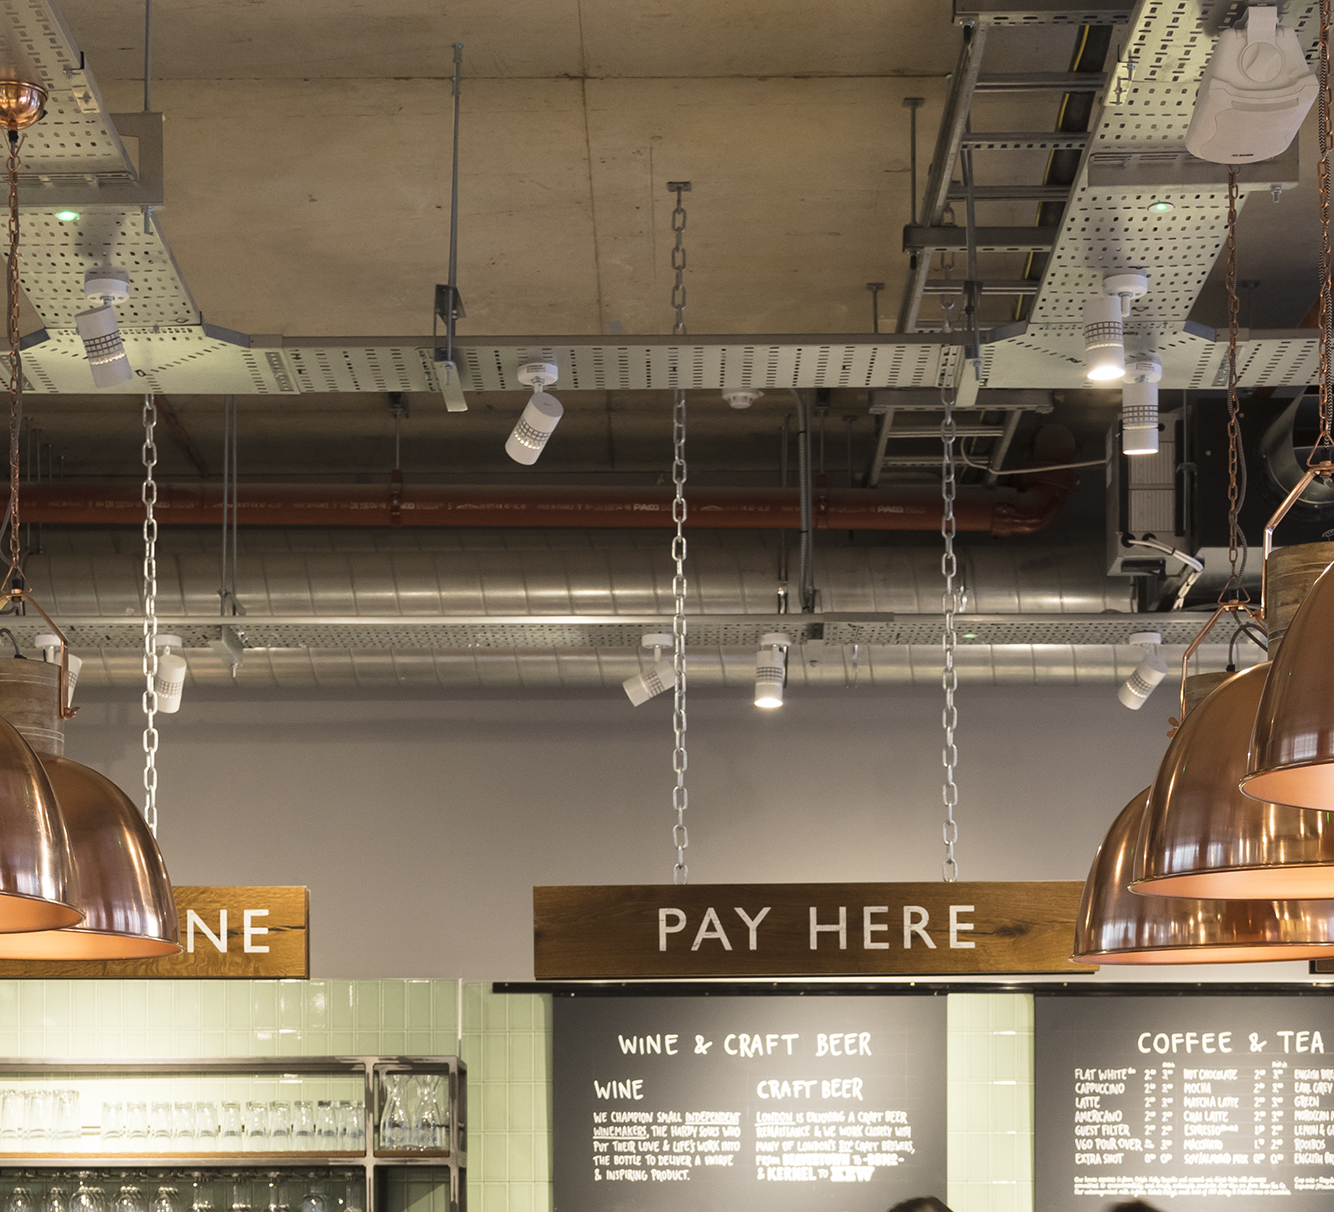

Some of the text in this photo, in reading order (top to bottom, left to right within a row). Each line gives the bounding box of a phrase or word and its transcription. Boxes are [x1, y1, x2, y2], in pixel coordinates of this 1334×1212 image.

[188, 908, 271, 953] NE
[658, 905, 976, 952] PAY HERE
[618, 1031, 872, 1058] WINE & CRAFT BEER
[1137, 1030, 1325, 1055] COFFEE & TEA
[1074, 1068, 1097, 1080] FLAT
[1098, 1068, 1127, 1080] WHITE
[1198, 1068, 1238, 1080] CHOCOLATE
[1294, 1068, 1319, 1080] ENGLISH
[593, 1079, 644, 1100] WINE
[756, 1077, 864, 1101] CRAFT BEER
[1074, 1082, 1126, 1094] CAPPUCCINO
[1183, 1082, 1212, 1094] MOCHA
[1294, 1082, 1333, 1095] EARL GREY
[1075, 1096, 1100, 1109] LATTE
[1183, 1095, 1239, 1108] MATCHA LATTE
[1294, 1095, 1319, 1108] GREEN
[593, 1111, 741, 1124] WE CHAMPION SMALL INDEPENDENT
[755, 1110, 908, 1125] LONDON IS ENJOYING A CRAFT BEER
[1074, 1109, 1123, 1123] AMERICANO
[1183, 1110, 1229, 1123] CHAI LATTE
[1294, 1109, 1329, 1121] MOROCCAN
[593, 1125, 741, 1139] WINEMAKERS, THE HARDY SOULS WHO
[756, 1125, 911, 1138] RENAISSANCE & WE WORK CLOSELY WITH
[1074, 1124, 1131, 1136] GUEST FILTER
[1183, 1124, 1221, 1136] ESPRESSO
[1294, 1124, 1318, 1136] LEMON
[1319, 1124, 1325, 1136] &
[593, 1140, 741, 1153] PUT THEIR LOVE & LIFE'S WORK INTO
[756, 1140, 779, 1152] MANY
[782, 1140, 794, 1152] OF
[797, 1140, 836, 1152] LONDON'S
[855, 1140, 880, 1153] CRAFT
[1095, 1138, 1118, 1150] POUR
[1118, 1138, 1143, 1152] OVER
[1183, 1138, 1223, 1151] MACCHIATO
[1294, 1138, 1326, 1151] ROOIBOS
[593, 1154, 734, 1167] THE BOTTLE TO DELIVER A UNIQUE
[756, 1154, 780, 1167] FROM
[782, 1153, 850, 1167] BEAVERTOWN
[852, 1154, 862, 1167] TO
[1074, 1153, 1124, 1165] EXTRA SHOT
[1232, 1152, 1249, 1165] MILK
[1294, 1152, 1323, 1165] ENGLISH
[594, 1168, 690, 1181] & INSPIRING PRODUCT.
[757, 1166, 875, 1182] & KERNEL TO KEW
